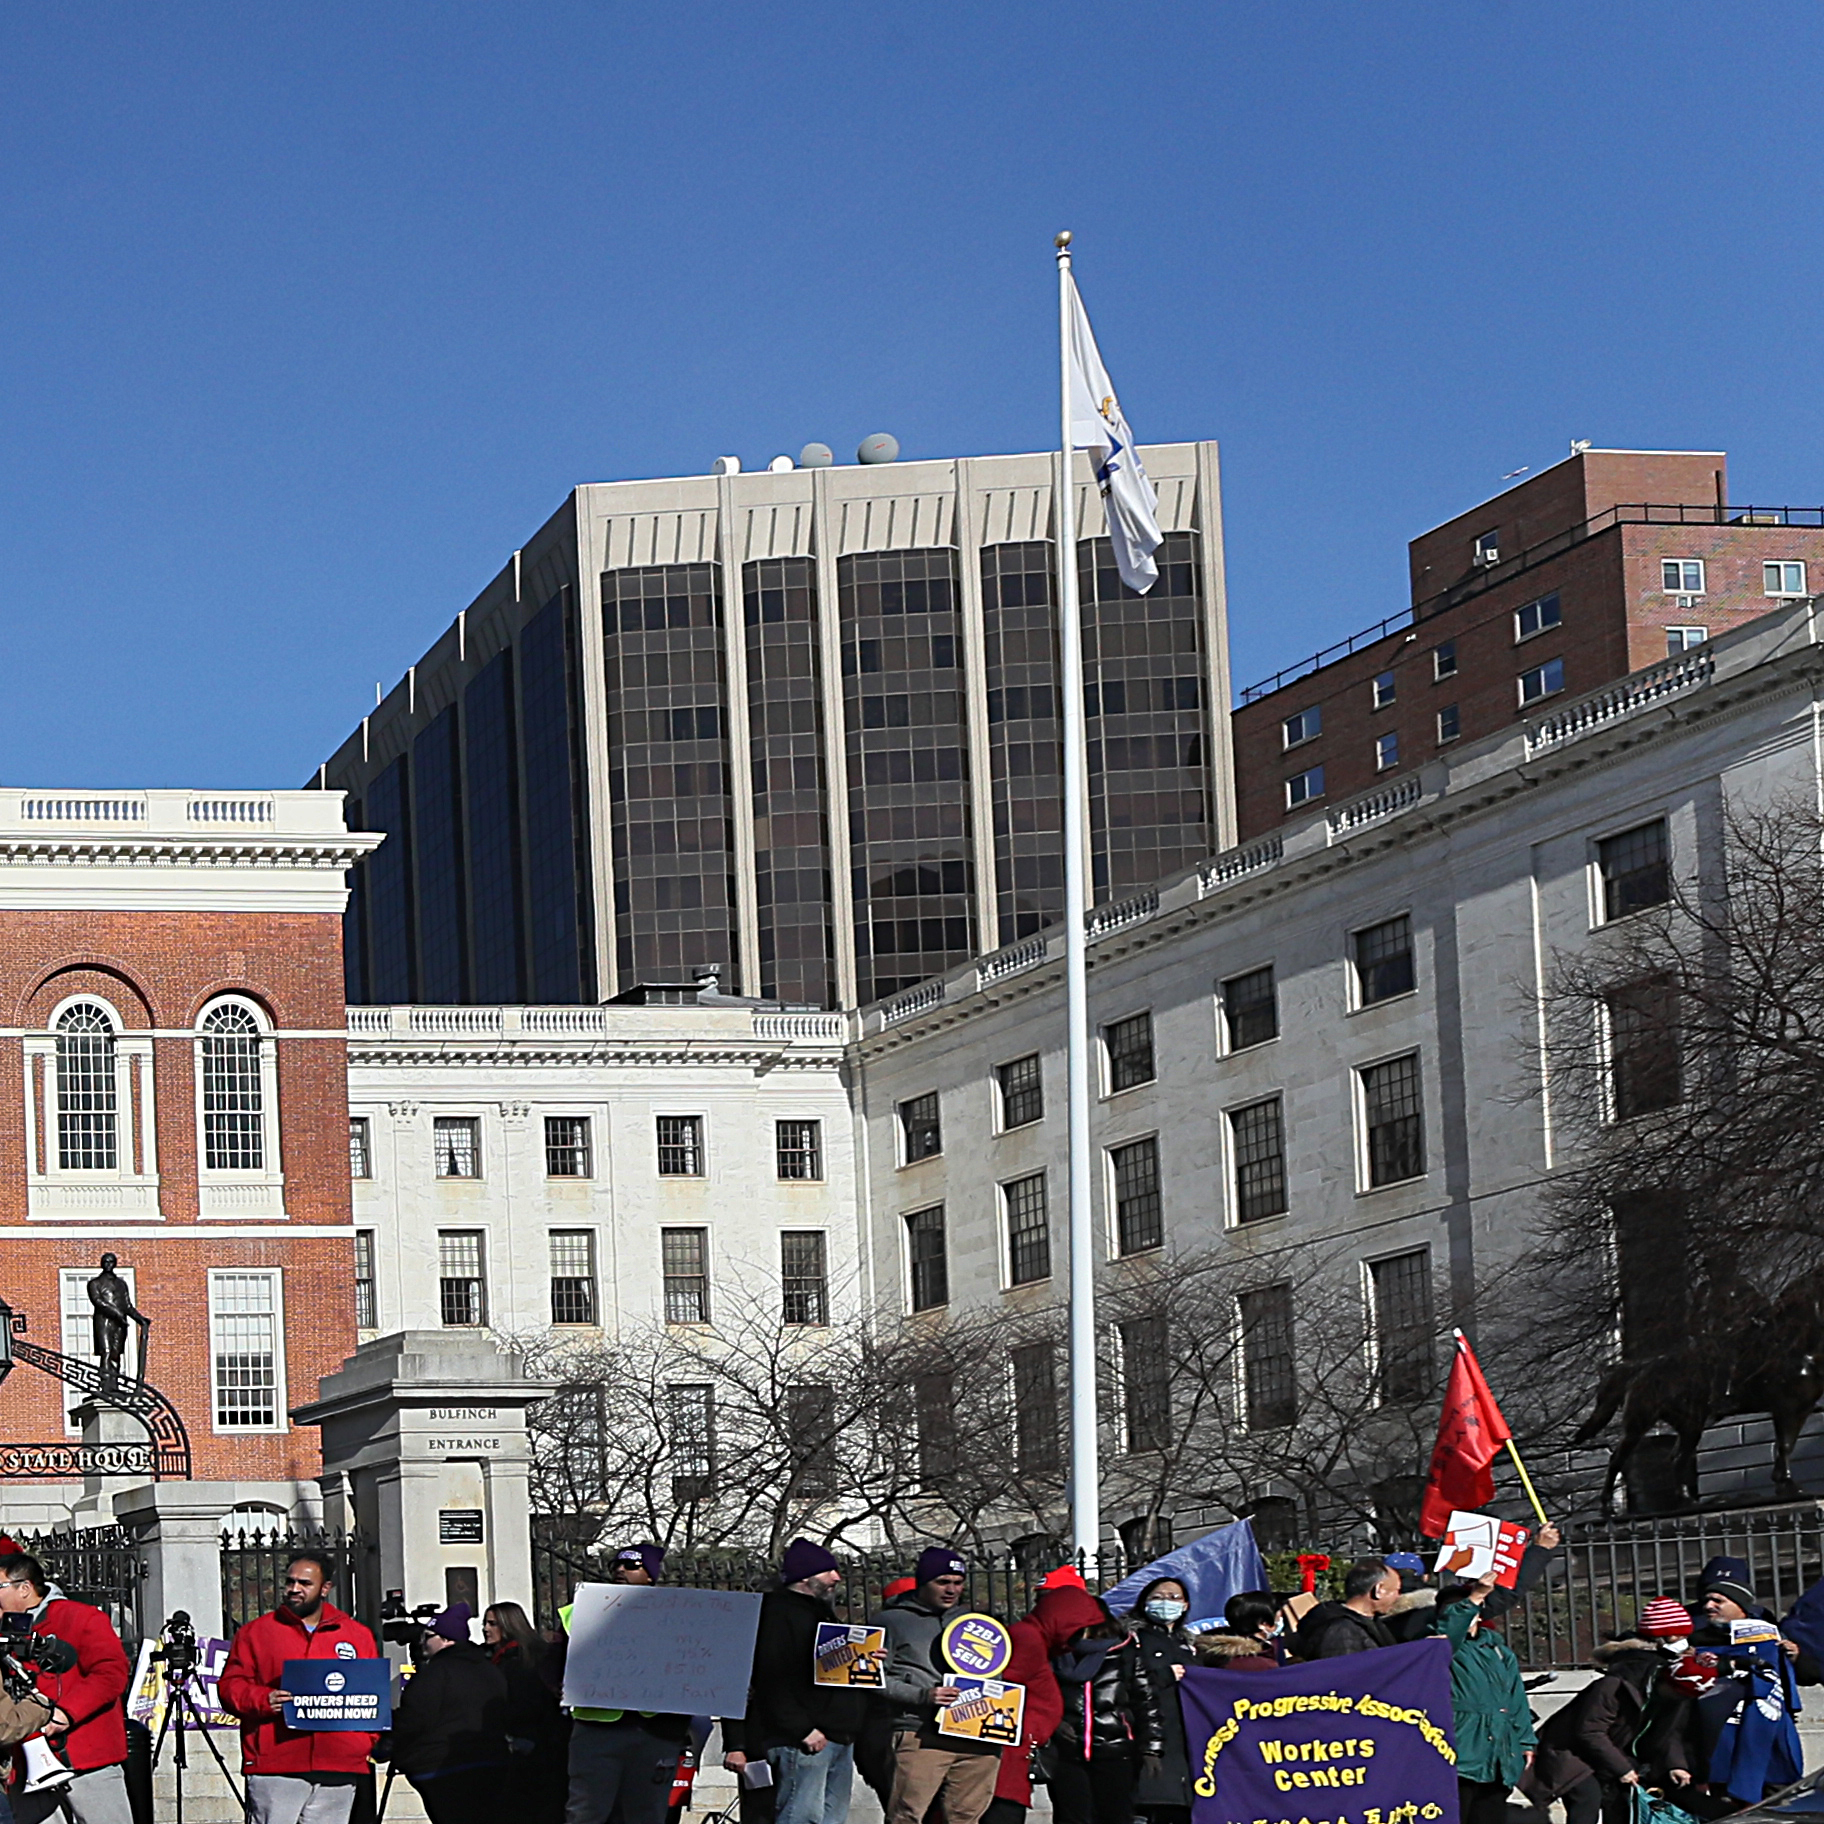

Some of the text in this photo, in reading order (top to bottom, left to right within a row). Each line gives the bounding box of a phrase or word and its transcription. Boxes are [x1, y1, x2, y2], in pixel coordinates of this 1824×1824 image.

[8, 1452, 70, 1469] STATE
[79, 1450, 151, 1468] HOUSE
[963, 1621, 1002, 1646] 32BJ
[952, 1647, 991, 1671] SEIU
[293, 1694, 378, 1706] DRIVERS NEED
[950, 1699, 992, 1724] UNITED
[1233, 1691, 1353, 1720] Progressive
[296, 1707, 378, 1719] A UNION NOW!
[1258, 1738, 1374, 1764] Workers
[1274, 1766, 1367, 1792] Center
